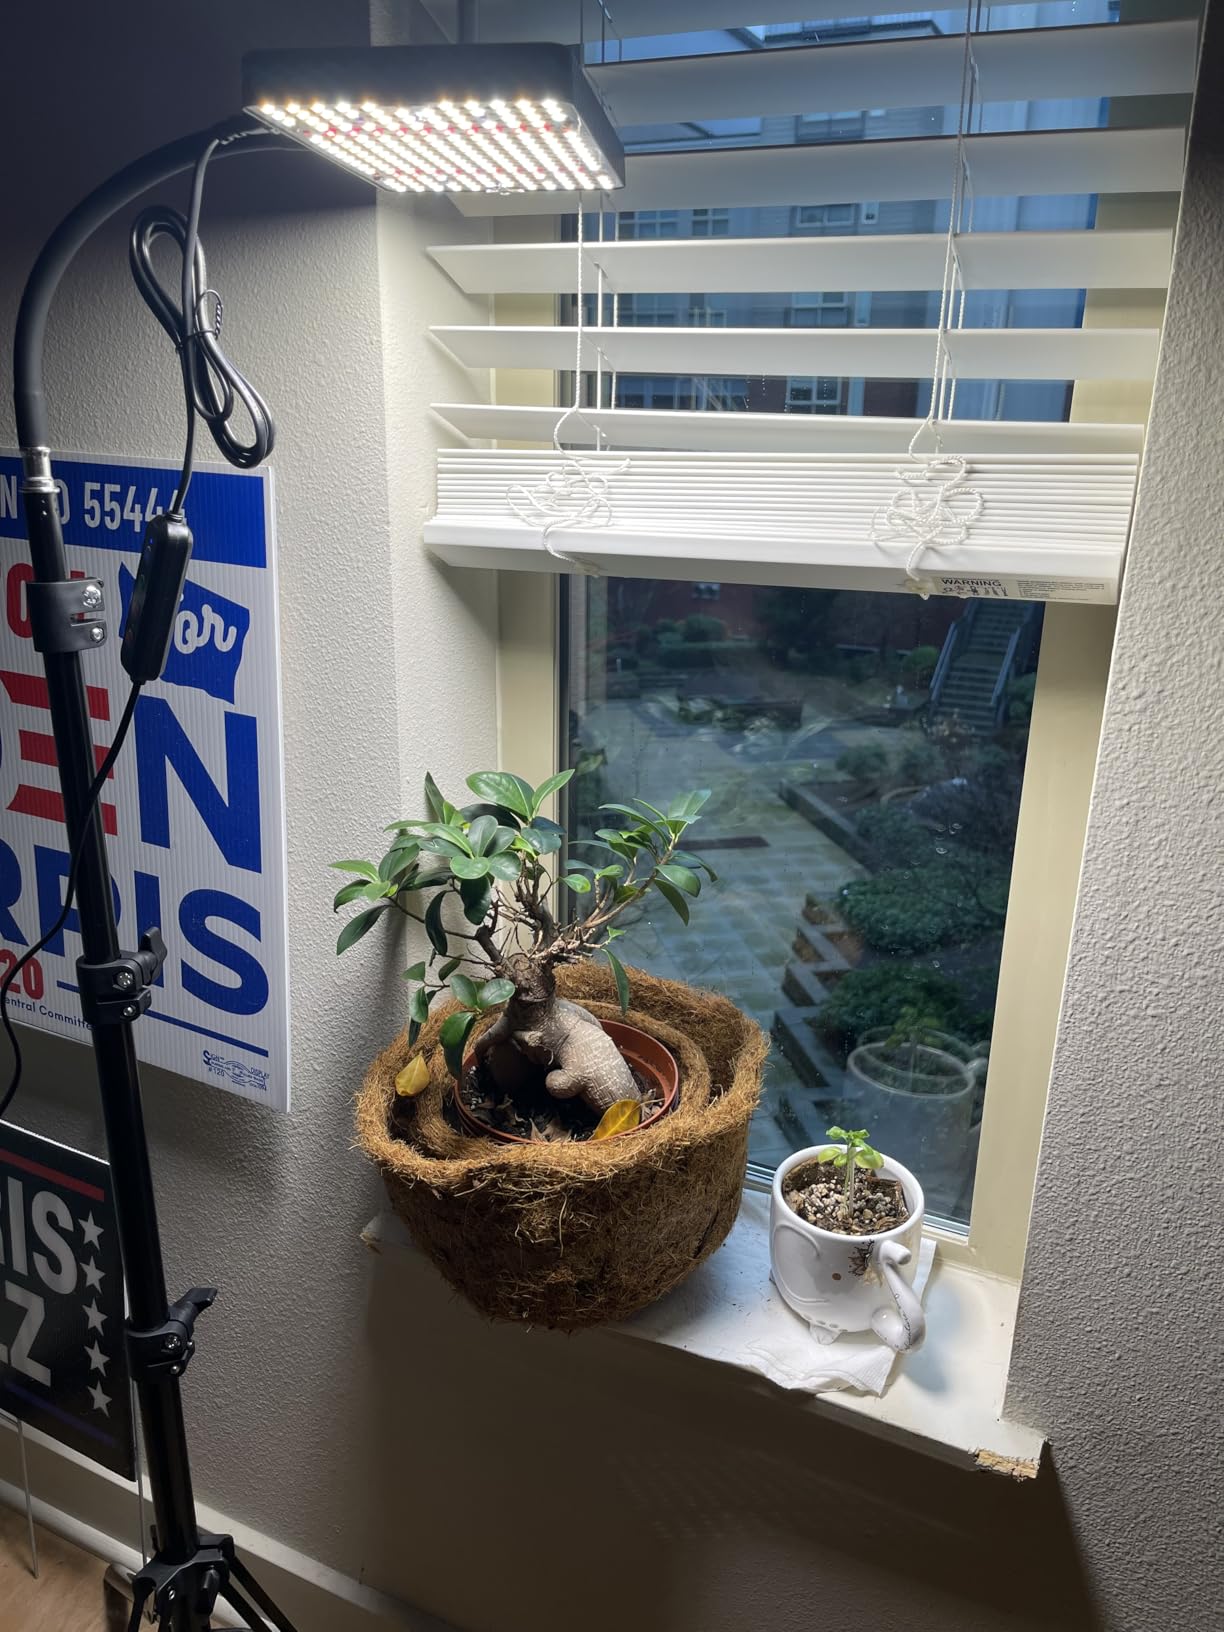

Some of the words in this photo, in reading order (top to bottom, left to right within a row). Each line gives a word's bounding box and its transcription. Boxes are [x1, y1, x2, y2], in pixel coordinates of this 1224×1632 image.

[941, 578, 1003, 588] WARNING
[173, 594, 238, 656] or
[1, 997, 36, 1013] entral
[39, 1005, 96, 1030] Committe
[0, 1175, 78, 1295] IS
[0, 1279, 52, 1387] Z
